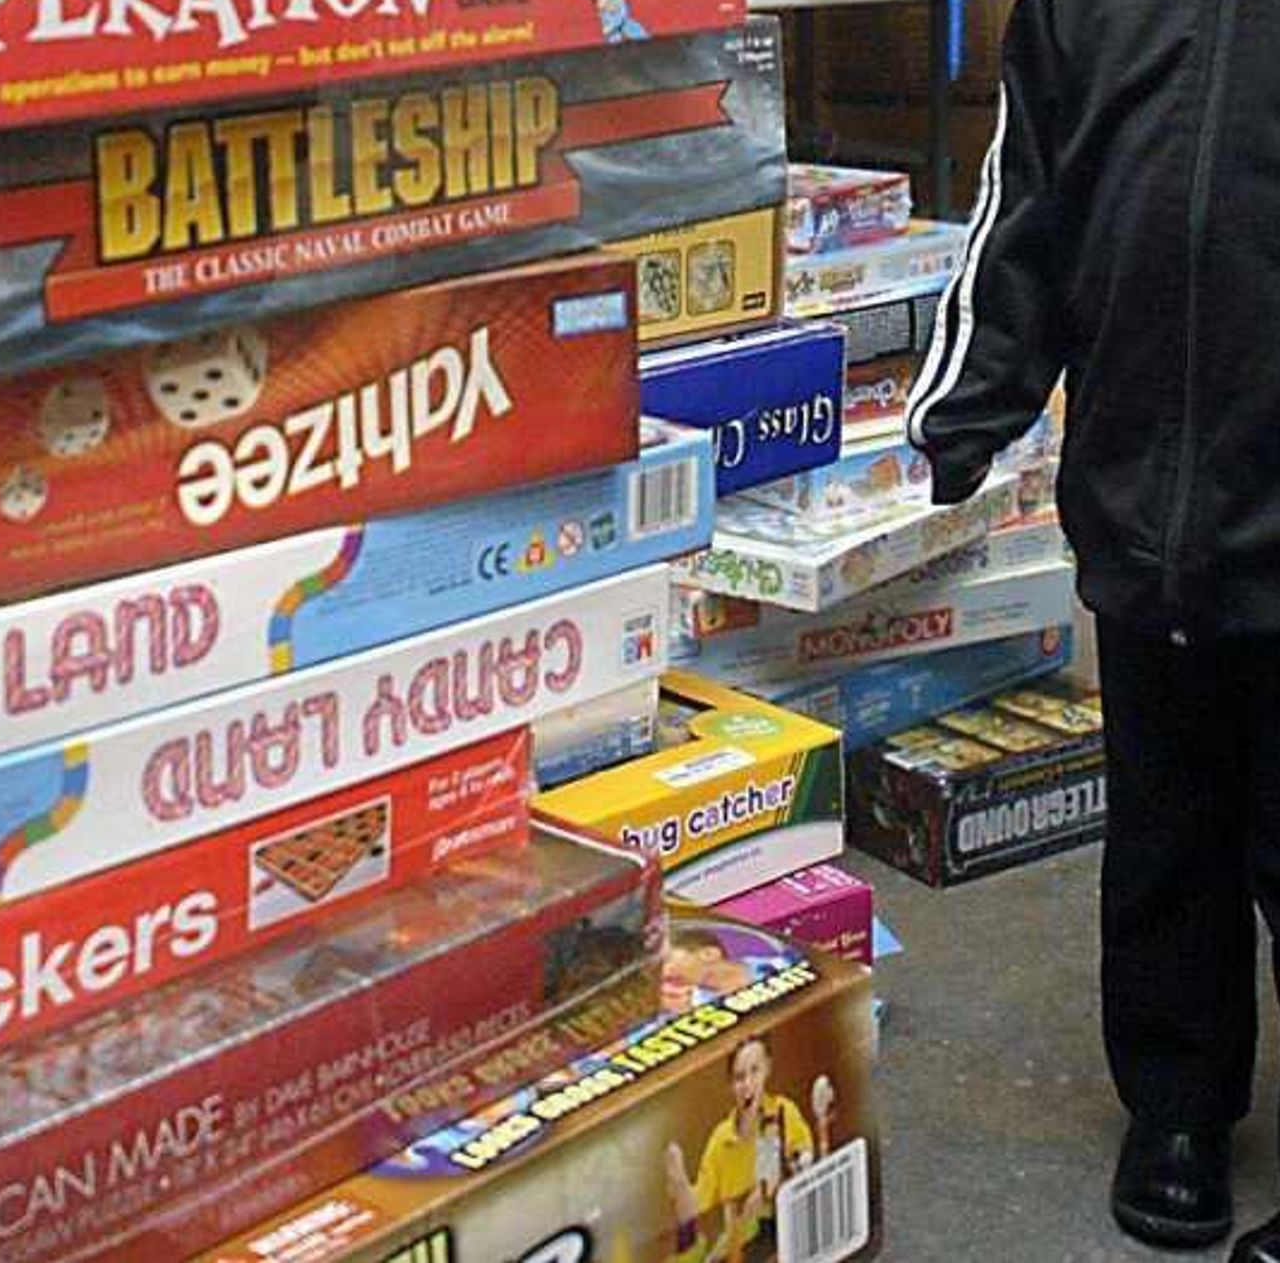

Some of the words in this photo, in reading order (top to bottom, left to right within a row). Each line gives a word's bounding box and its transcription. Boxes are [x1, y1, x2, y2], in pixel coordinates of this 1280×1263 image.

[0, 69, 119, 104] operations
[98, 78, 560, 262] BATTLESHIP
[145, 265, 186, 294] THE
[195, 242, 291, 282] CLASSIC
[294, 231, 368, 262] NAVAL
[372, 212, 456, 248] COMBAT
[459, 203, 512, 232] GAME
[178, 326, 513, 525] Yahtzee
[758, 394, 835, 448] Glass
[3, 582, 222, 717] LAND
[362, 618, 584, 757] CANDY
[141, 690, 338, 822] LAND
[621, 818, 679, 853] bug
[687, 779, 795, 834] catcher
[612, 1003, 739, 1075] TASTES
[107, 1092, 224, 1185] MADE
